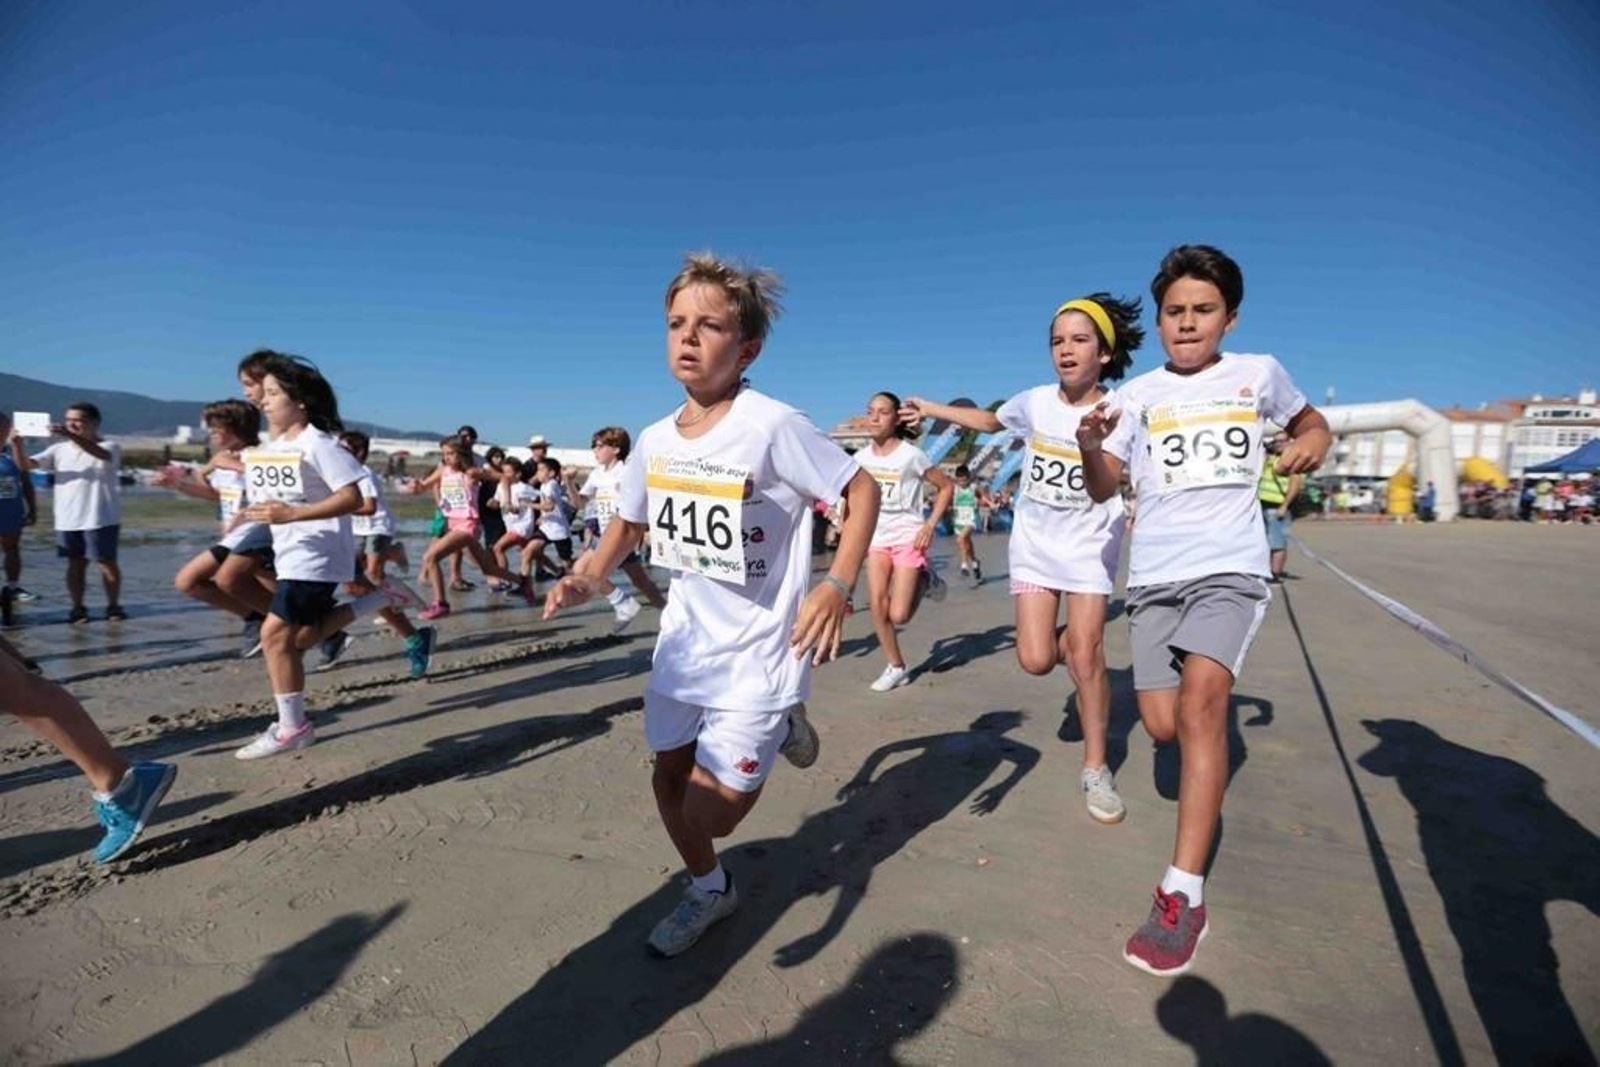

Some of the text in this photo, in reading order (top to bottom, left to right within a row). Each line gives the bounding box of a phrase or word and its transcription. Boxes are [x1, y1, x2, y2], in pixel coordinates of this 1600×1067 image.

[1162, 426, 1250, 467] 369
[252, 465, 297, 487] 398
[1031, 455, 1085, 491] 526
[656, 497, 733, 551] 416
